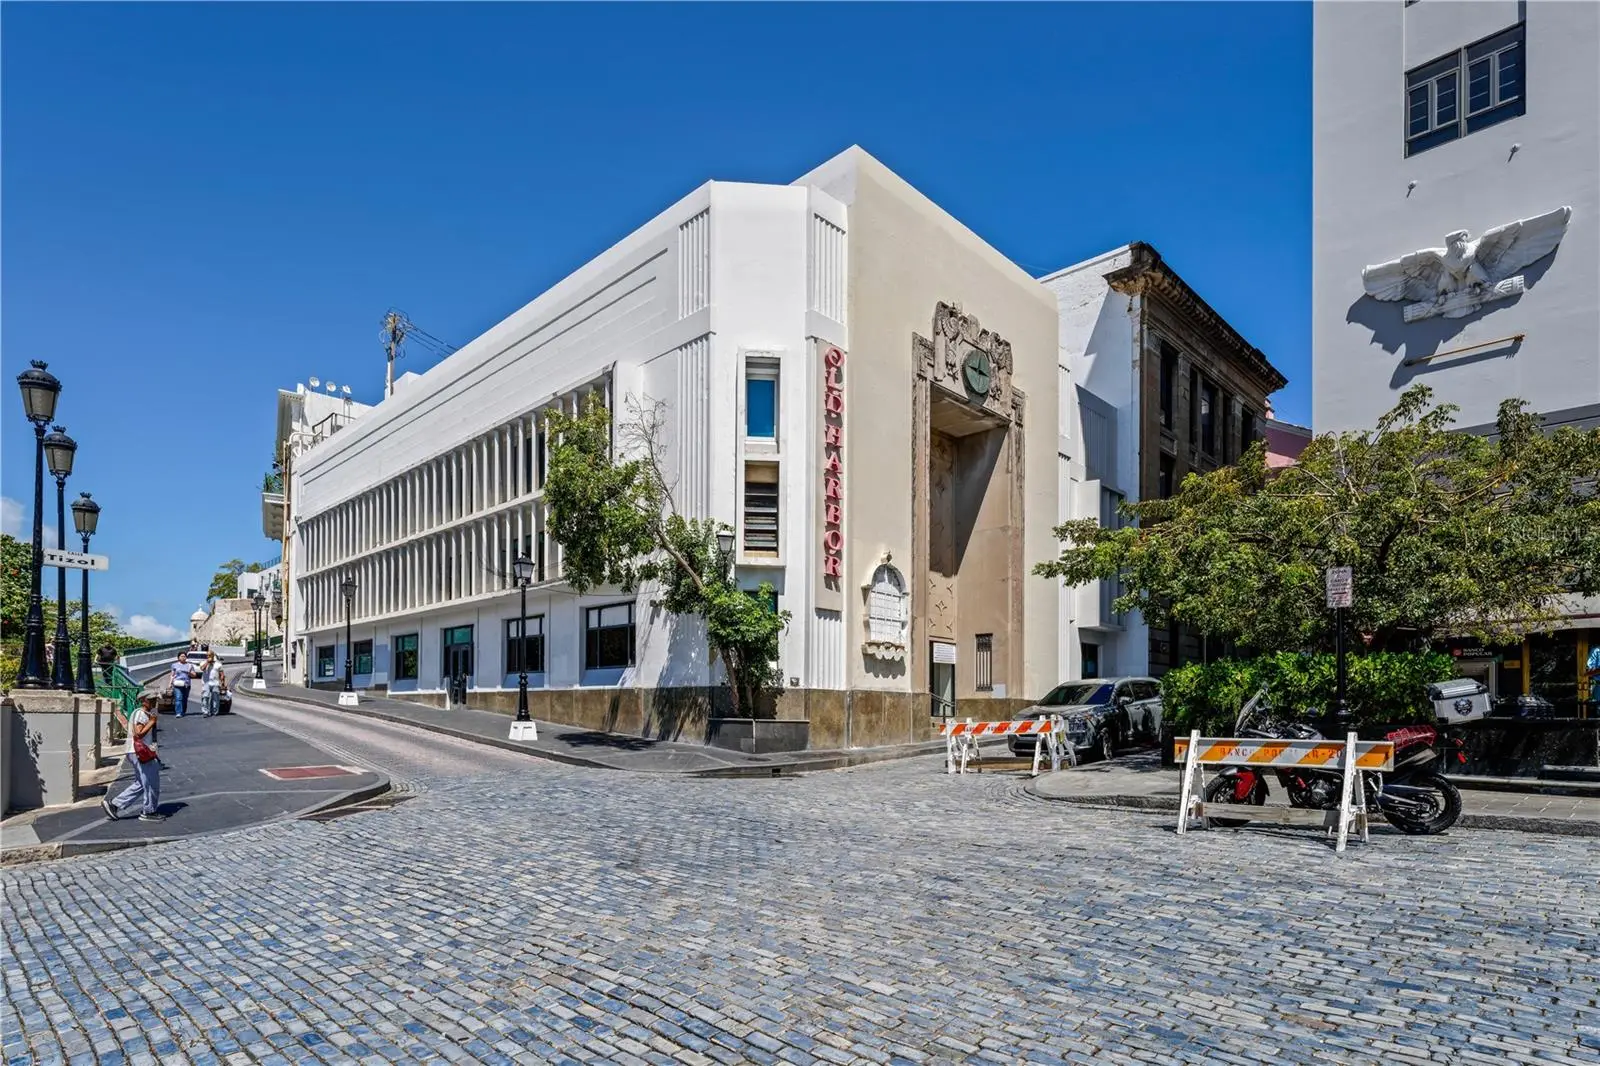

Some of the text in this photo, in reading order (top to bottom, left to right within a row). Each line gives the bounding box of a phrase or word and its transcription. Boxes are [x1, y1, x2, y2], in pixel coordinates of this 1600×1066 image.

[824, 347, 845, 577] OLD HARBOR
[47, 553, 95, 565] Tizol
